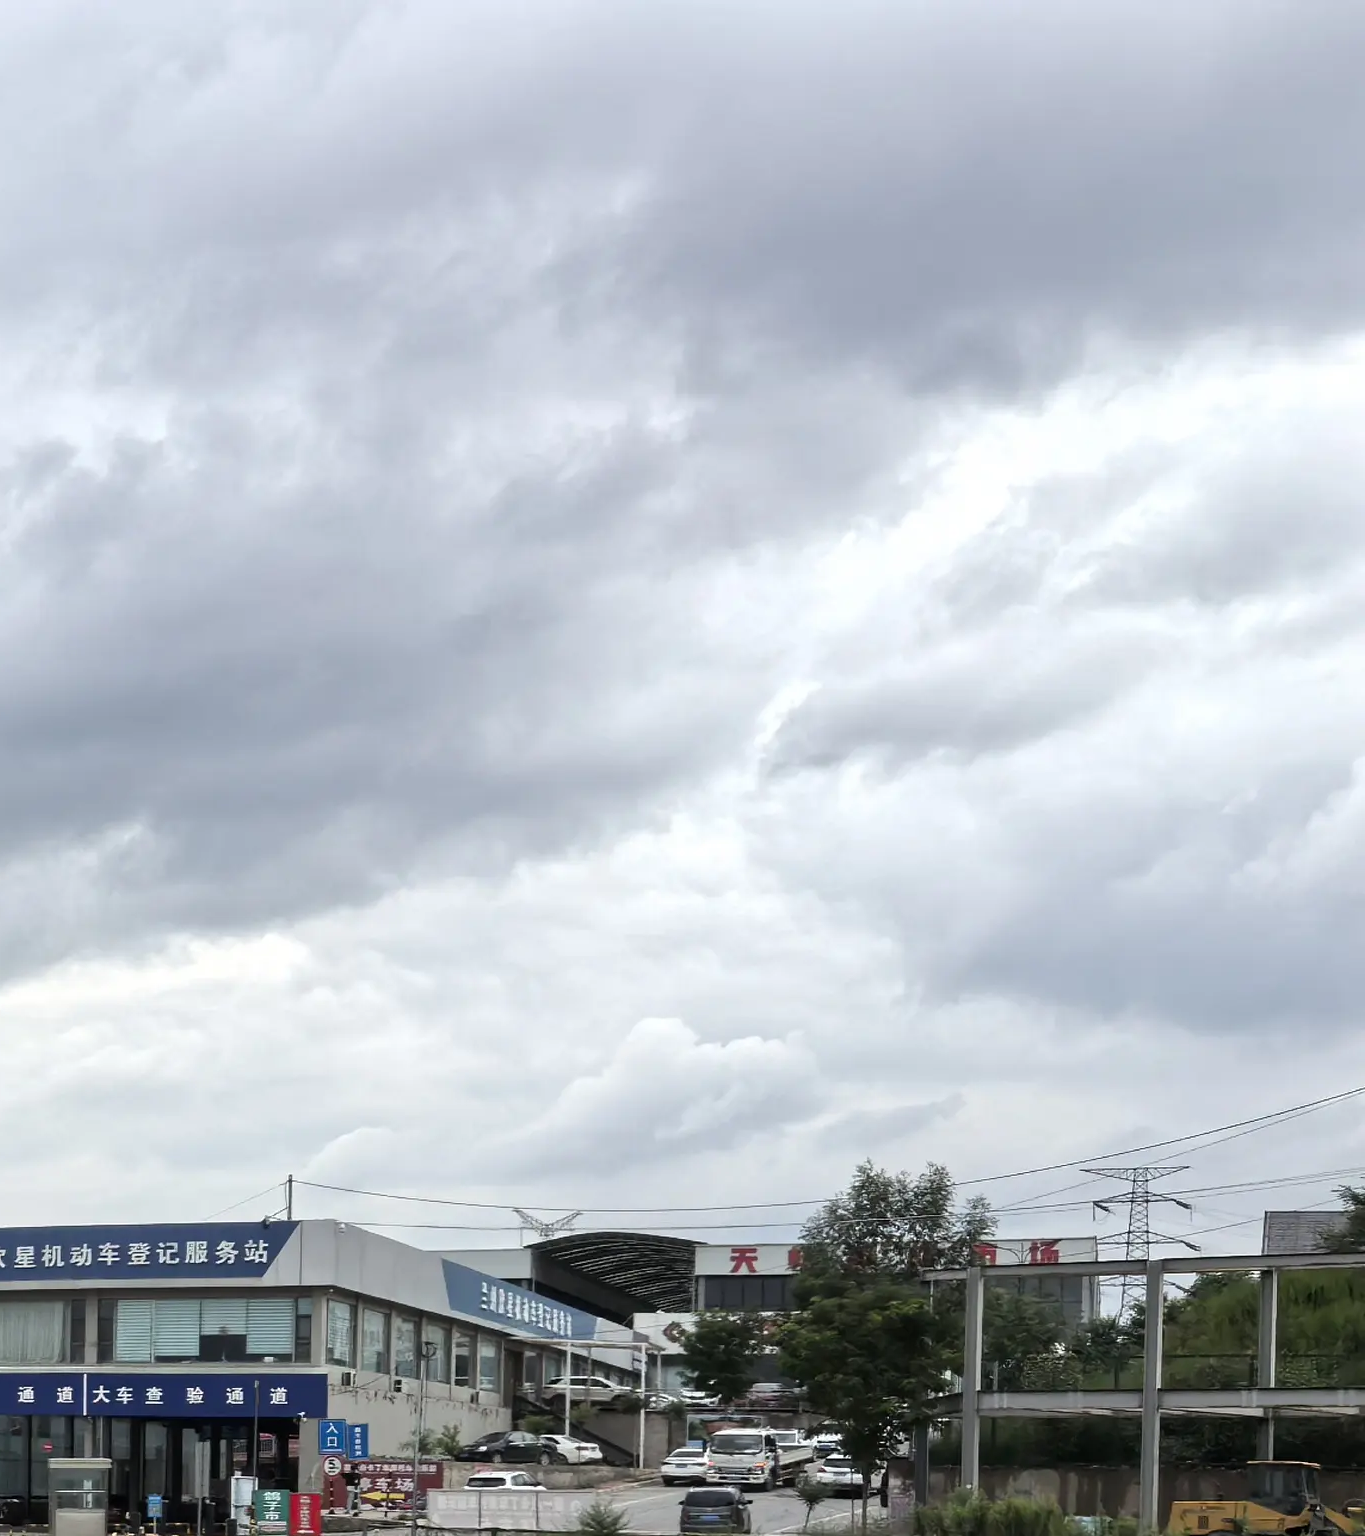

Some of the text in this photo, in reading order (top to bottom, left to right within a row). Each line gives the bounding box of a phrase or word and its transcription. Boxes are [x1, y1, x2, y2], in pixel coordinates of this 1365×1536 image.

[92, 1385, 289, 1406] 大车查验通道
[326, 1422, 339, 1447] 入口
